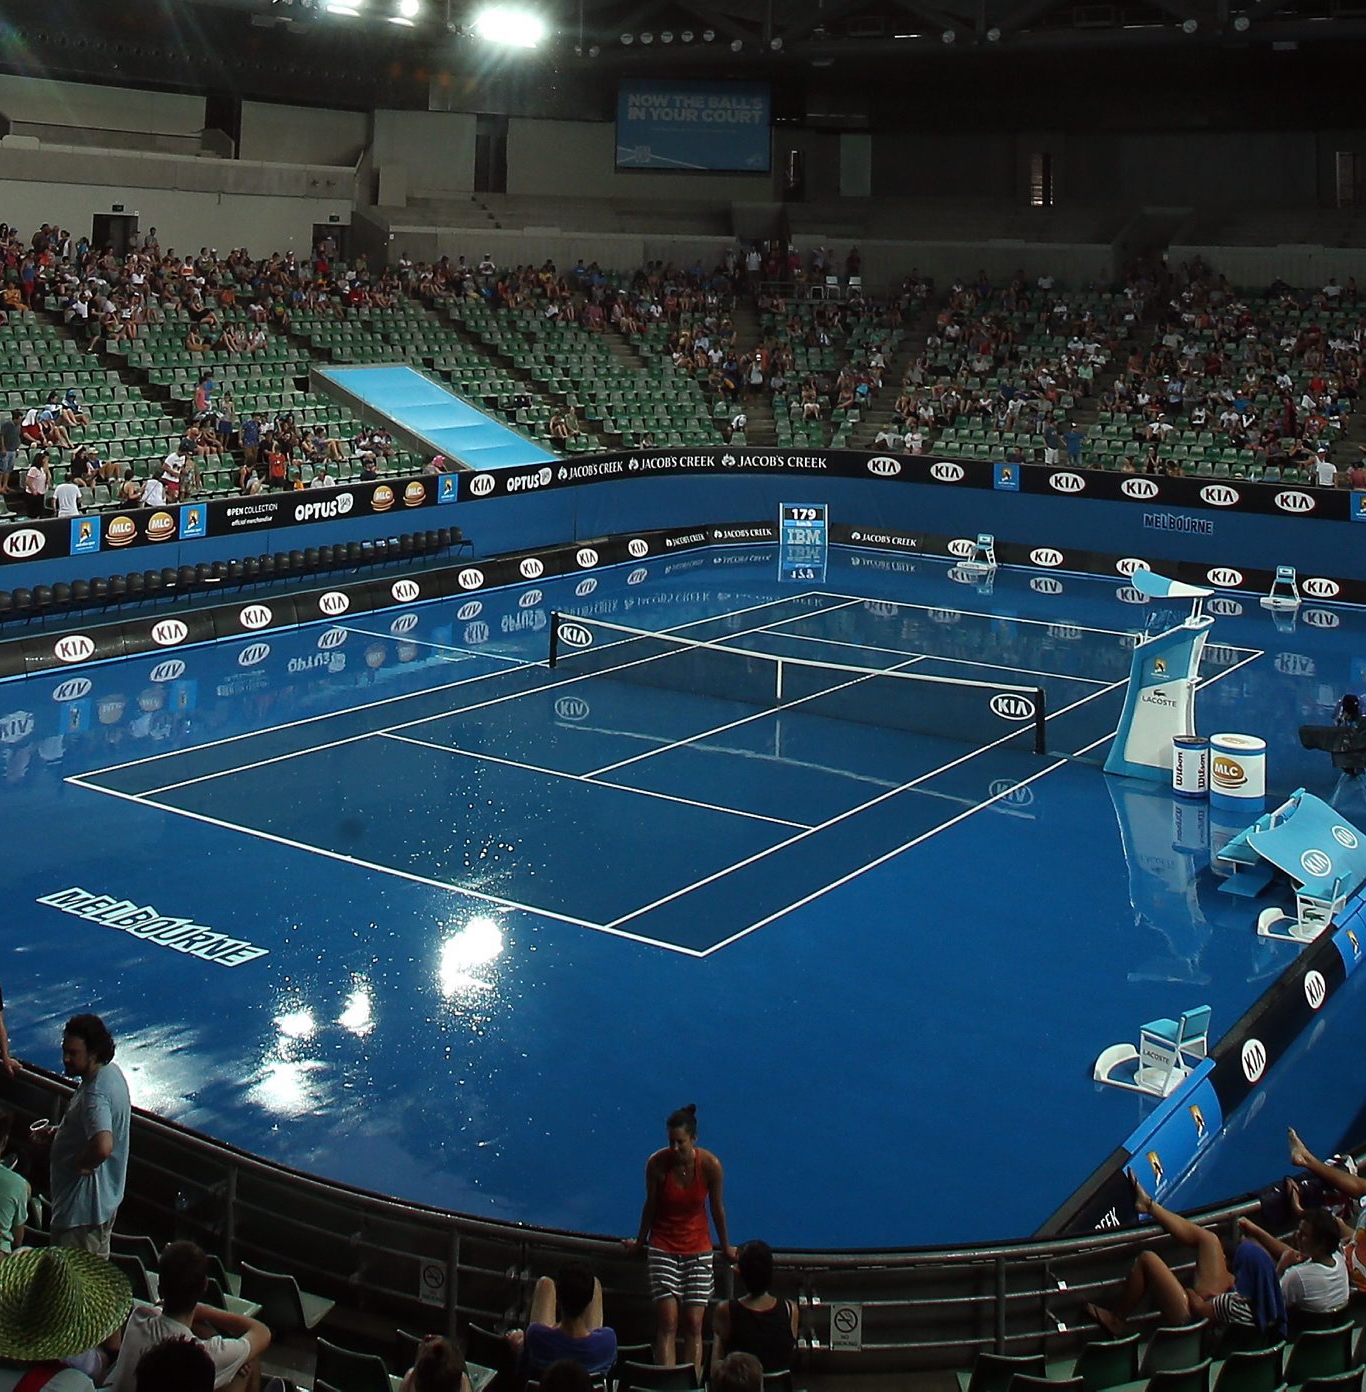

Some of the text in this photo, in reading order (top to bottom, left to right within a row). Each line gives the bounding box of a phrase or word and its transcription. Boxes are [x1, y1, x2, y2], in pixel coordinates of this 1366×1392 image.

[628, 94, 669, 107] NOW
[673, 95, 705, 108] THE
[628, 108, 763, 124] IN YOUR COURT
[599, 461, 624, 475] CREEK
[640, 455, 715, 470] JACOB'S CREEK
[737, 455, 827, 469] JACOB'S CREEK
[871, 460, 898, 474] KIA
[934, 465, 961, 479] KIA
[473, 479, 492, 492] KIA
[507, 474, 539, 492] OPTUS
[1053, 475, 1081, 490] KIA
[1125, 481, 1154, 496] KIA
[1205, 488, 1234, 503] KIA
[1279, 494, 1311, 510] KIA
[227, 503, 278, 516] OPEN COLLECTION
[295, 499, 338, 522] OPTUS
[791, 508, 817, 520] 179
[111, 522, 133, 534] MLC
[151, 518, 171, 528] MLC
[1143, 513, 1213, 535] MELBOURNE
[750, 528, 772, 536] CREEK
[787, 528, 821, 544] IBM
[8, 533, 40, 553] KIA
[629, 541, 647, 555] KIA
[891, 536, 917, 547] CREEK
[578, 551, 597, 564] KIA
[1033, 551, 1059, 564] KIA
[522, 561, 542, 574] KIA
[461, 572, 481, 586] KIA
[1211, 570, 1238, 584] KIA
[394, 583, 417, 598] KIA
[1307, 581, 1335, 595] KIA
[321, 596, 347, 611] KIA
[243, 609, 269, 624] KIA
[155, 624, 185, 641] KIA
[563, 626, 587, 644] KIA
[59, 640, 90, 658] KIA
[997, 698, 1028, 716] KIA
[1141, 695, 1177, 708] LACOSTE
[1175, 752, 1183, 786] Wilson
[1197, 754, 1205, 789] Wilson
[1214, 762, 1239, 777] MLC
[1305, 976, 1325, 1002] KIA
[1143, 1048, 1171, 1065] LACOSTE
[1243, 1044, 1265, 1078] KIA
